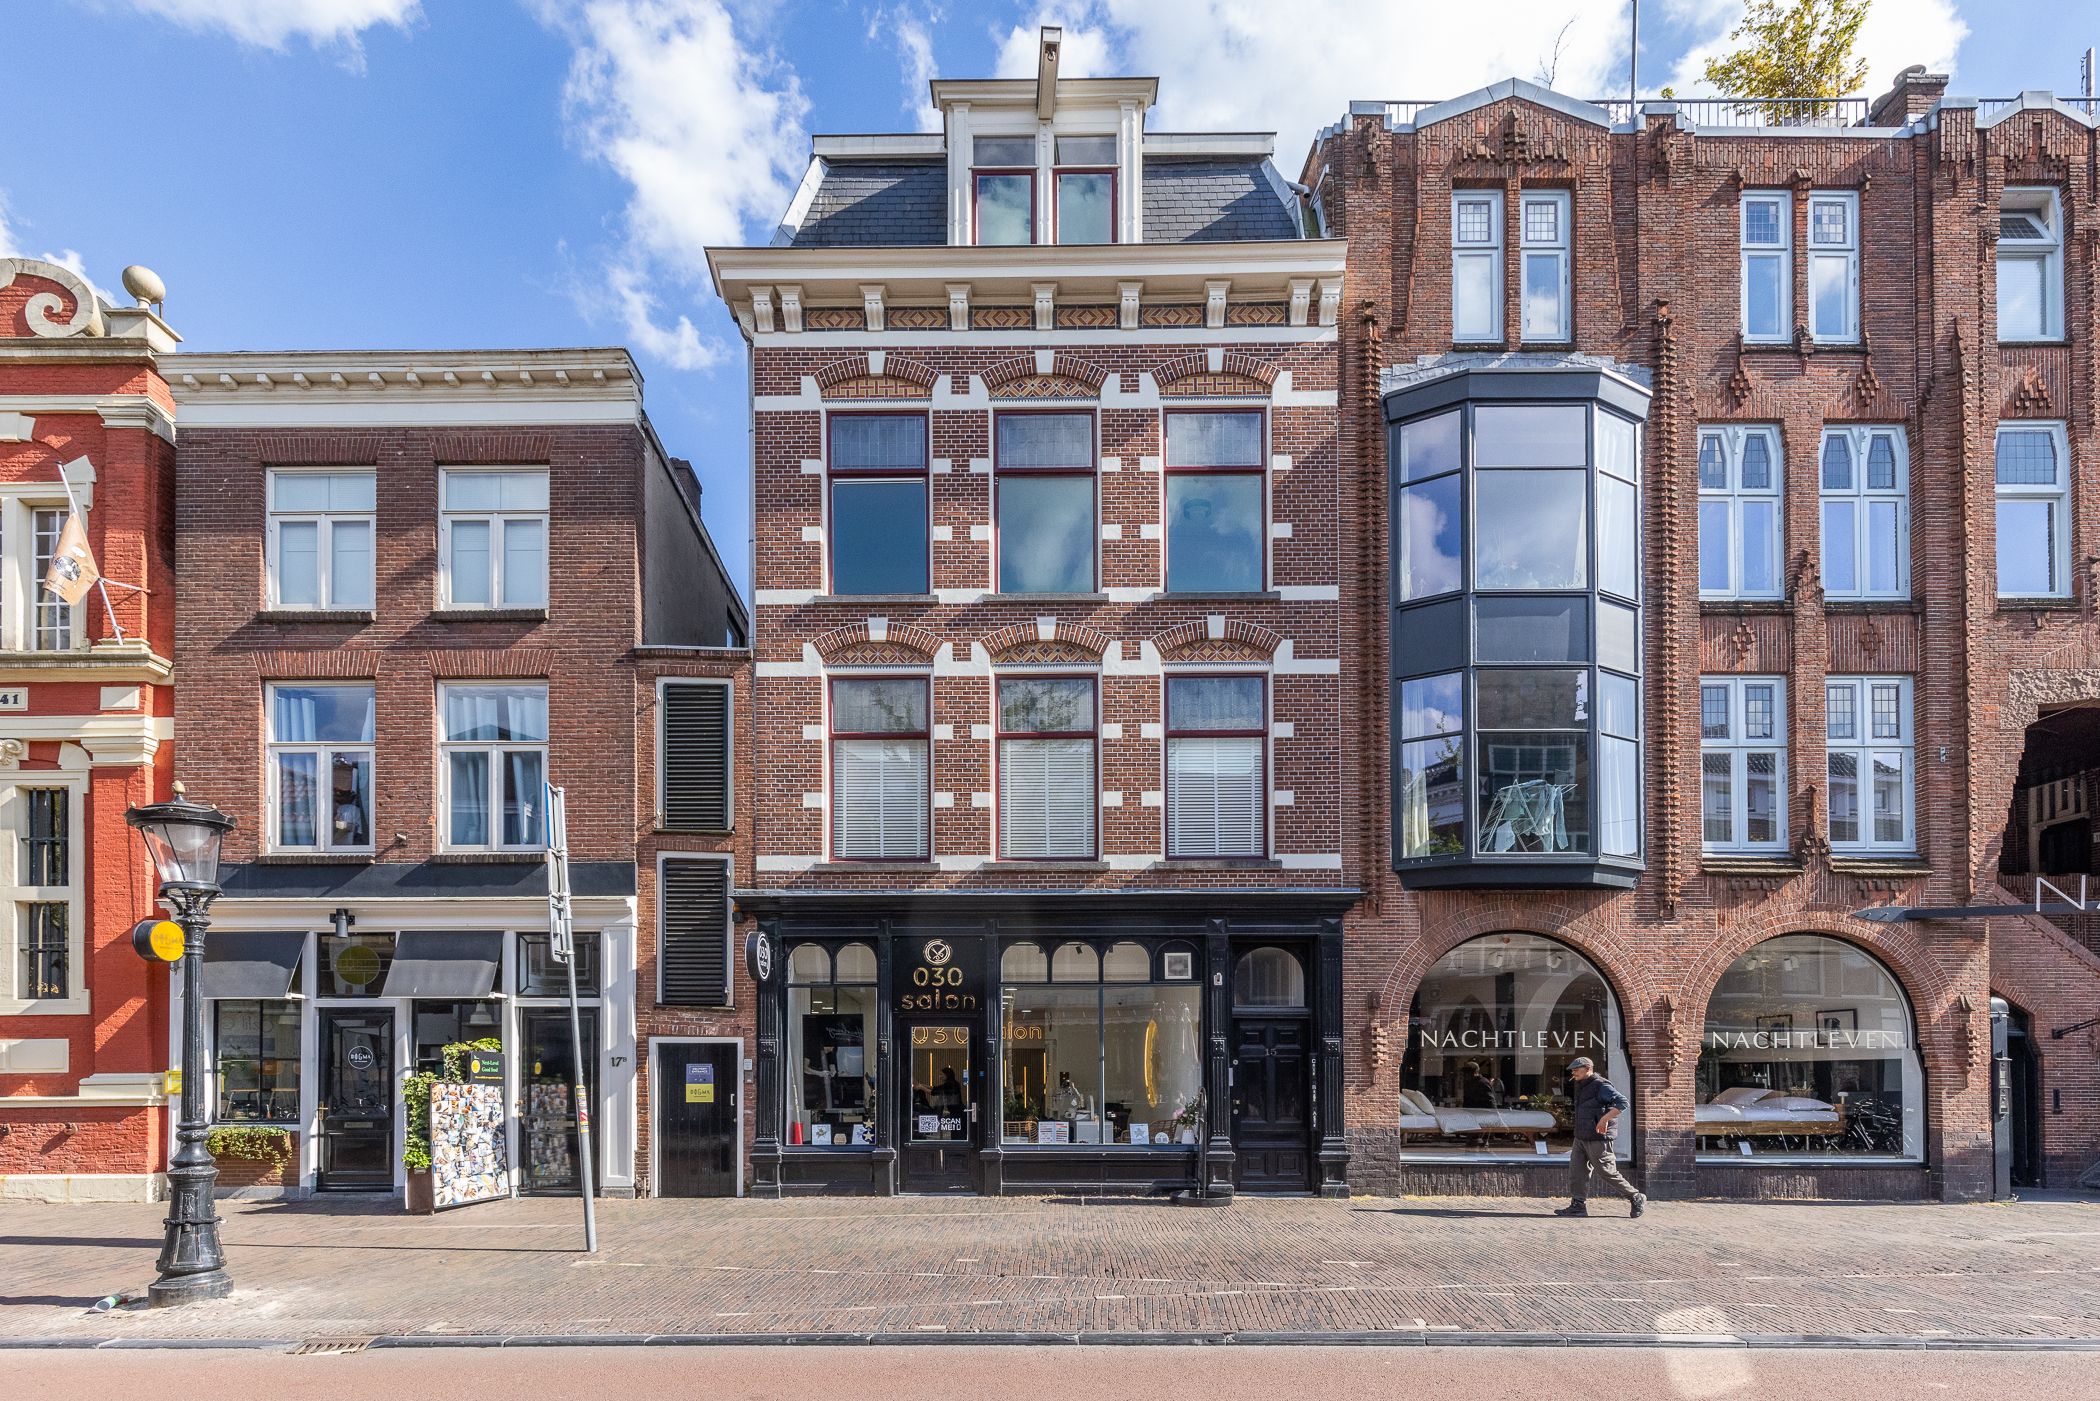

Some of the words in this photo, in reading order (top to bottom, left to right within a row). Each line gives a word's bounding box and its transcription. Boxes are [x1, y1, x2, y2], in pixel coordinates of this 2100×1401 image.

[913, 967, 963, 987] 030
[901, 989, 976, 1010] salon
[1421, 1029, 1606, 1049] NACHTLEVEN
[1712, 1031, 1899, 1050] NACHTLEVEN
[1265, 1048, 1277, 1056] 15
